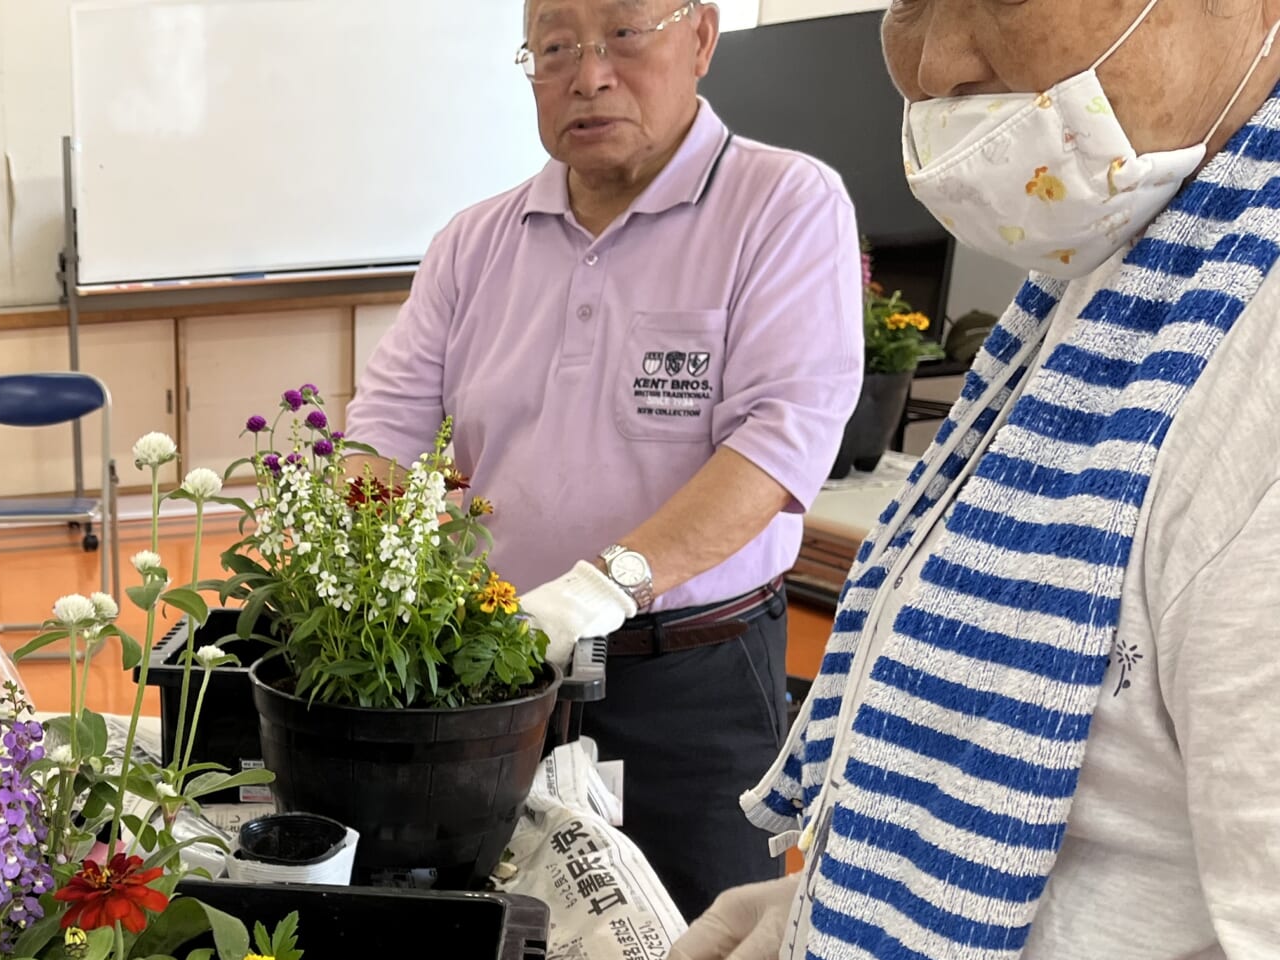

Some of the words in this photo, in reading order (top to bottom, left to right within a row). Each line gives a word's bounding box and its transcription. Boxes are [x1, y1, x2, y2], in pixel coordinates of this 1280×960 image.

[633, 378, 667, 389] KENT
[671, 379, 713, 391] BROS.
[549, 820, 628, 916] 立憲民主党
